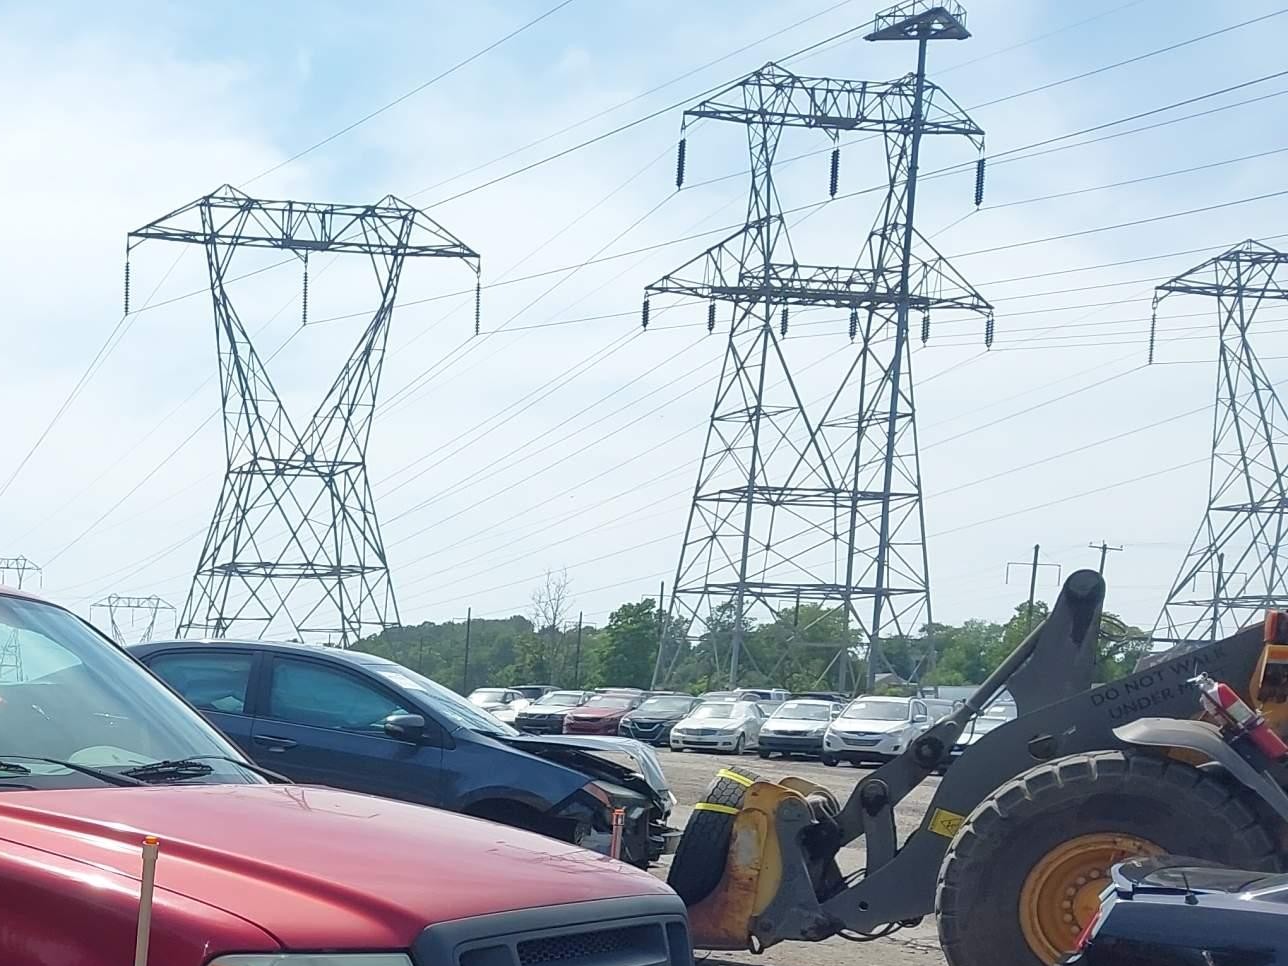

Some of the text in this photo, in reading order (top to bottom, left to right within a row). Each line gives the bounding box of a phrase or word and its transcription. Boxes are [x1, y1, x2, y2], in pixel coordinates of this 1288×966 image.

[1090, 688, 1120, 707] DO
[1125, 670, 1165, 694] NOT
[1108, 689, 1175, 720] UNDER
